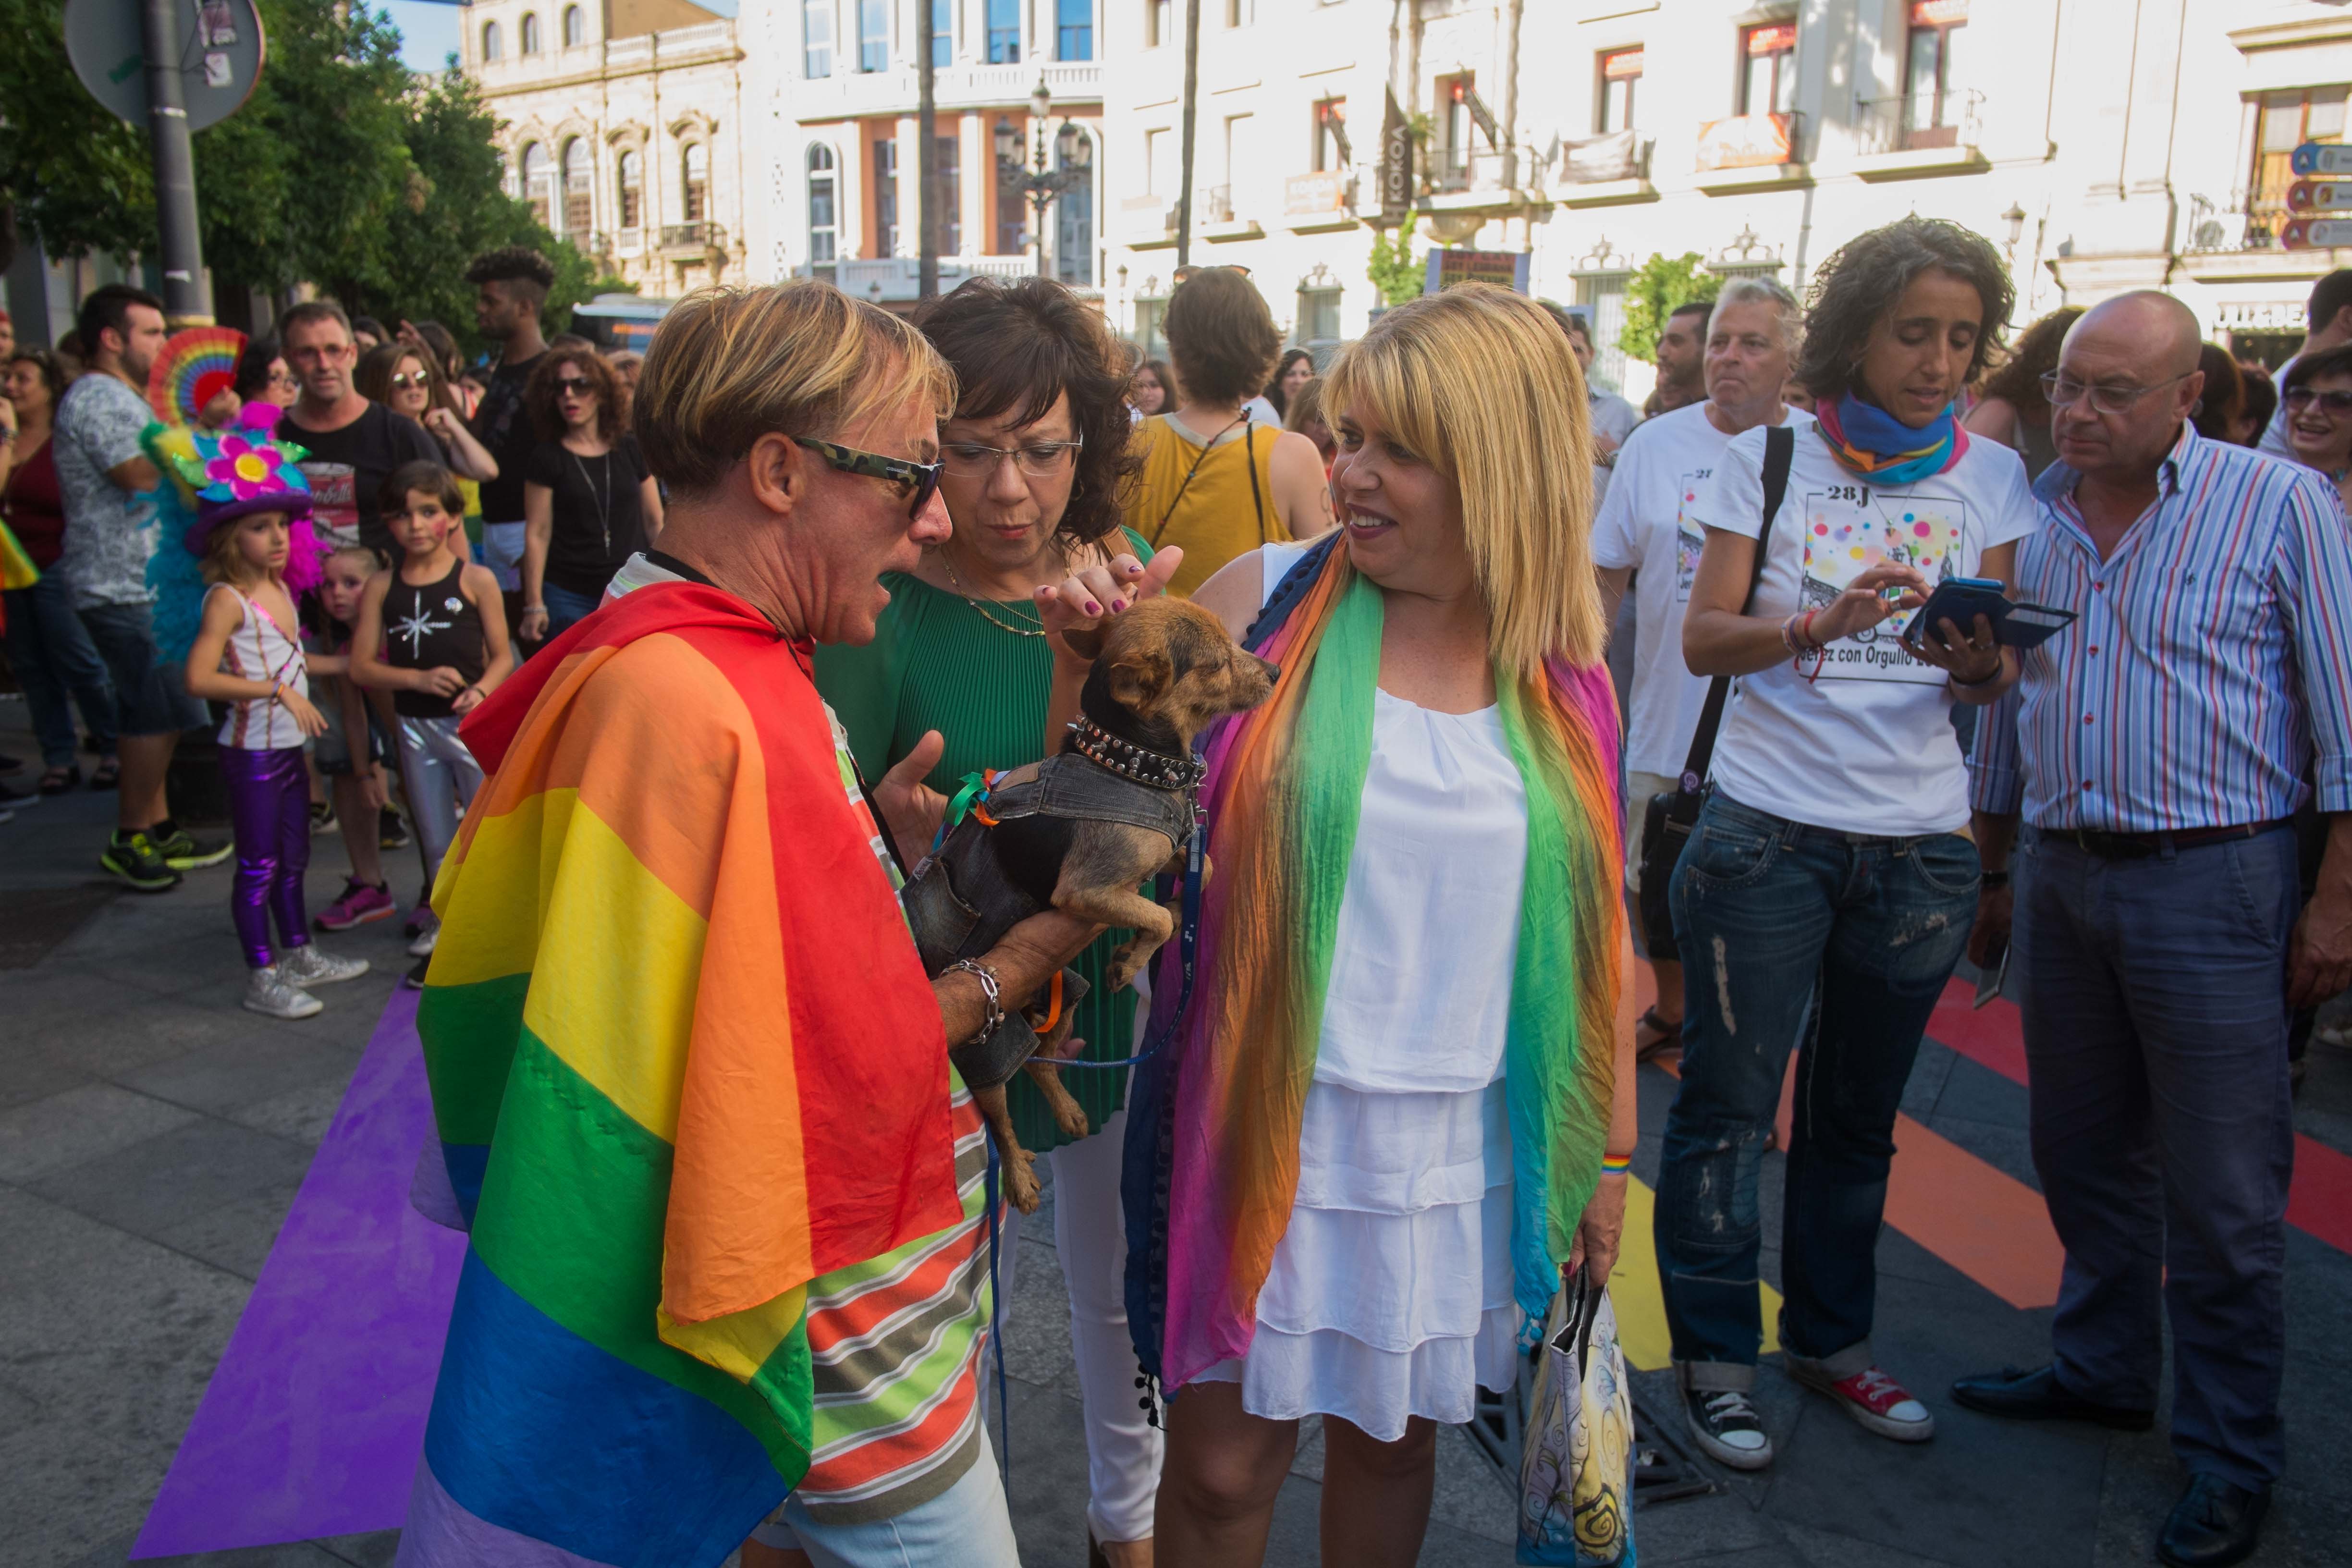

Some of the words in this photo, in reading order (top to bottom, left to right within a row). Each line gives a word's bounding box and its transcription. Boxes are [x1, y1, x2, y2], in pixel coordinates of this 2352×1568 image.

[1388, 125, 1407, 202] KOKOA
[1827, 485, 1869, 507] 28J
[1838, 649, 1862, 662] con
[1866, 645, 1913, 669] Orgullo
